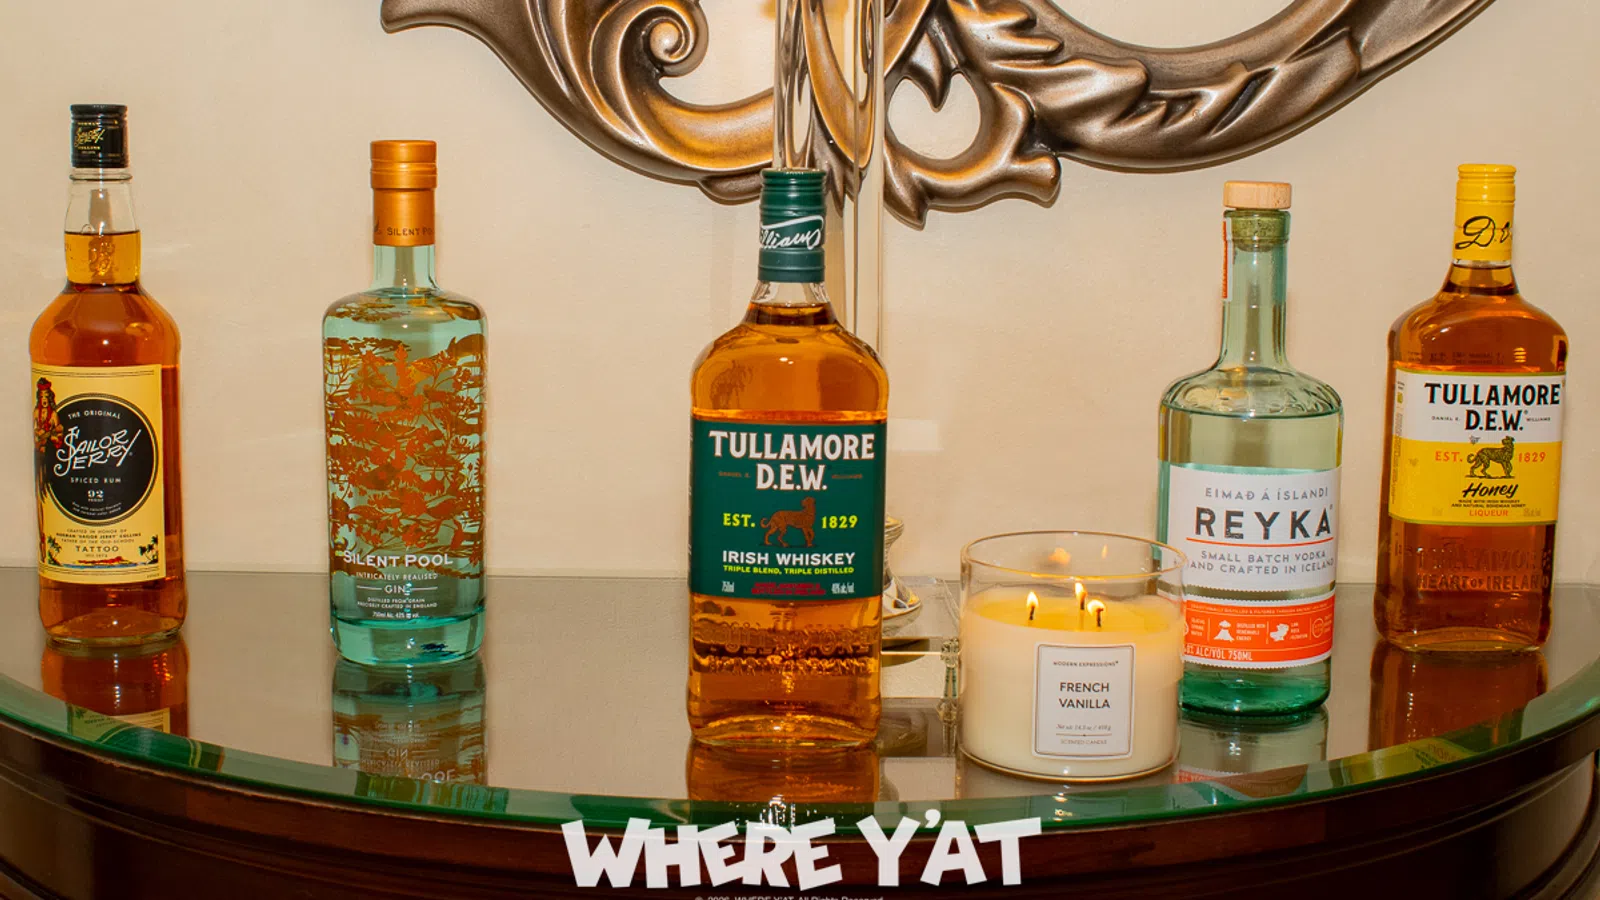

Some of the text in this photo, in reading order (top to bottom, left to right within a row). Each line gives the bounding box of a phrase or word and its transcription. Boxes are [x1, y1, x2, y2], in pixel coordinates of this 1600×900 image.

[387, 226, 421, 236] SILENT
[1424, 382, 1561, 406] TULLAMORE
[67, 410, 121, 420] THE ORIGINAL
[1464, 409, 1524, 431] D.E.W.
[708, 430, 875, 460] TULLAMORE
[1435, 450, 1463, 463] EST.
[1518, 451, 1547, 463] 1829
[756, 463, 828, 491] D.E.W.
[88, 490, 104, 499] 92
[1205, 488, 1254, 500] EIMAÐ
[1261, 488, 1271, 501] Á
[1462, 482, 1520, 499] Honey
[723, 512, 756, 528] EST.
[1469, 509, 1509, 518] LIQUEUR
[821, 514, 860, 530] 1829
[1195, 506, 1331, 540] REYKA
[342, 550, 454, 568] SILENT POOL
[722, 550, 857, 567] IRISH WHISKEY
[1201, 549, 1327, 564] SMALL BATCH VODKA
[723, 565, 856, 576] TRIPLE BLEND, TRIPLE DISTILLED
[1187, 557, 1335, 575] AND CRAFTED IN ICELAND
[355, 571, 439, 581] INTRICATELY REALISED
[384, 584, 407, 595] GIN
[1196, 645, 1226, 660] ALC/VOL
[1228, 650, 1253, 662] 750ML
[1060, 682, 1110, 693] FRENCH
[1058, 698, 1111, 709] VANILLA
